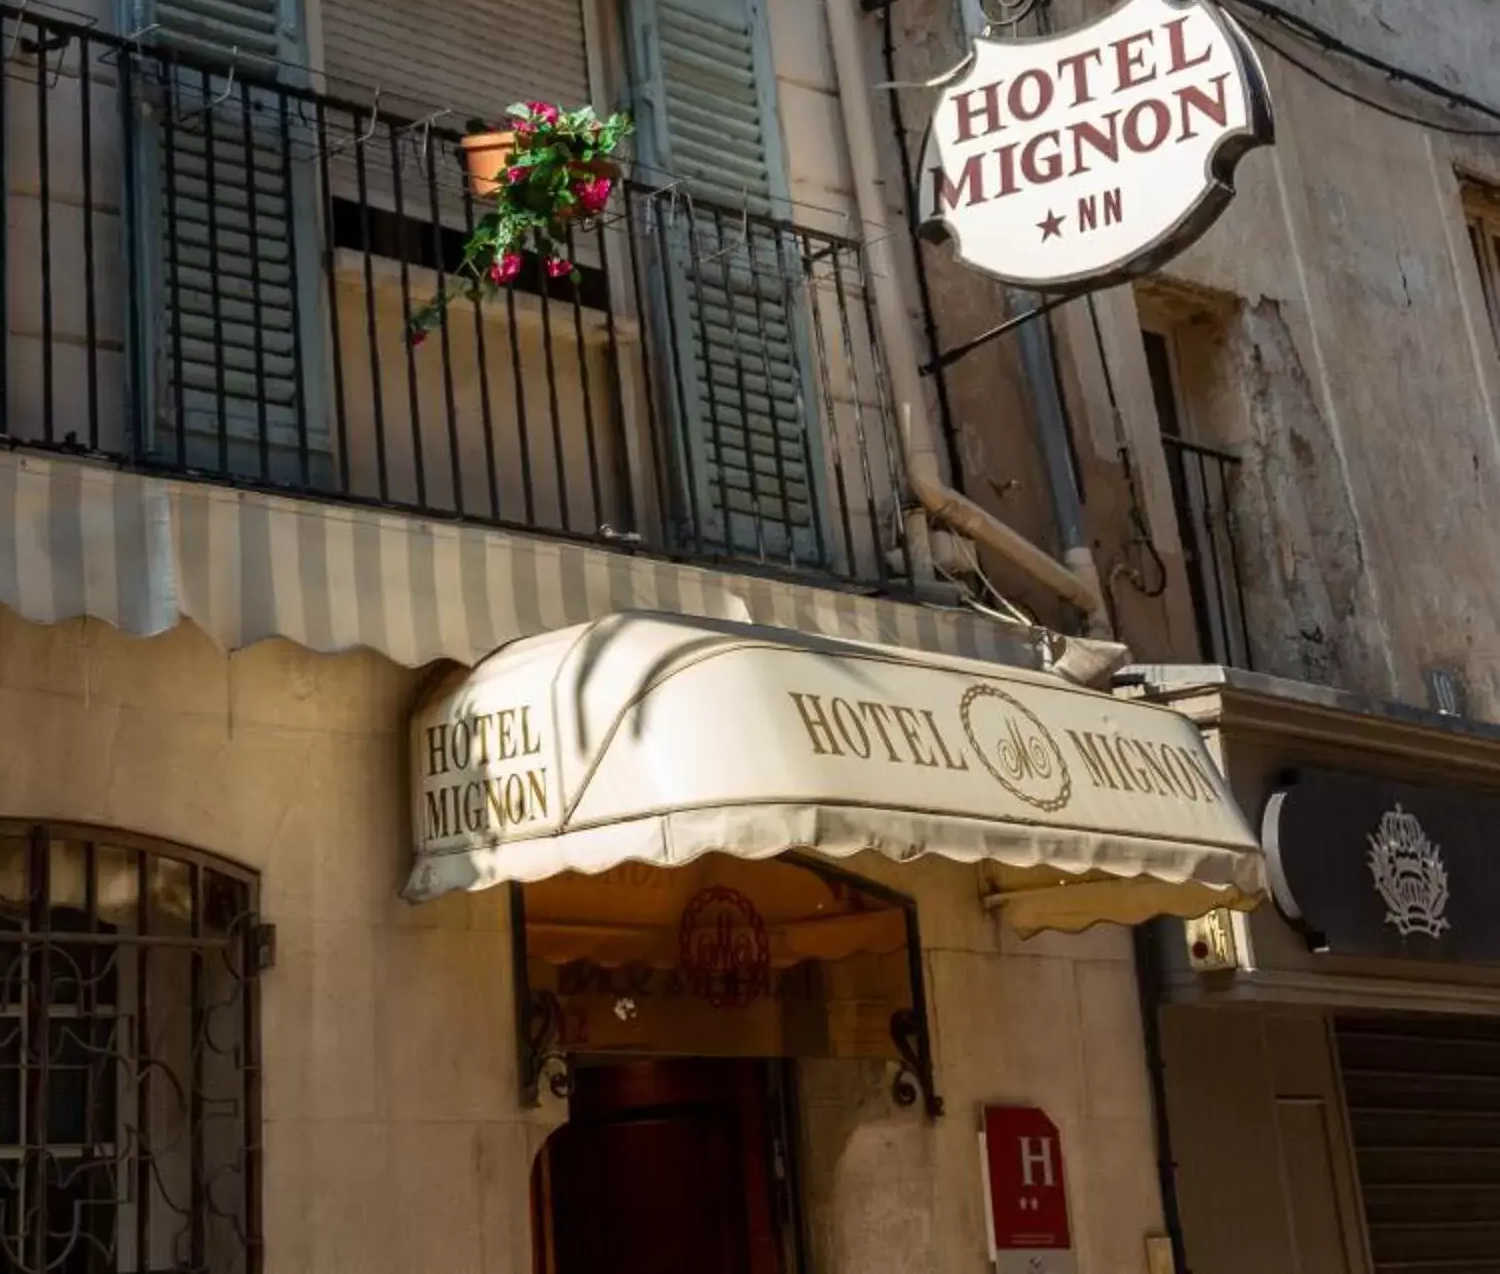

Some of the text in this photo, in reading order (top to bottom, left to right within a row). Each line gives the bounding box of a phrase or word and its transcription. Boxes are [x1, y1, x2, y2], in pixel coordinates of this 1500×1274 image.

[949, 15, 1214, 145] HOTEL
[928, 72, 1232, 217] MIGNON
[1078, 188, 1124, 233] NN
[426, 705, 541, 776] HOTEL
[788, 691, 969, 772] HOTEL
[1064, 728, 1223, 803] MIGNON
[425, 767, 549, 842] MIGNON
[1018, 1137, 1057, 1186] H
